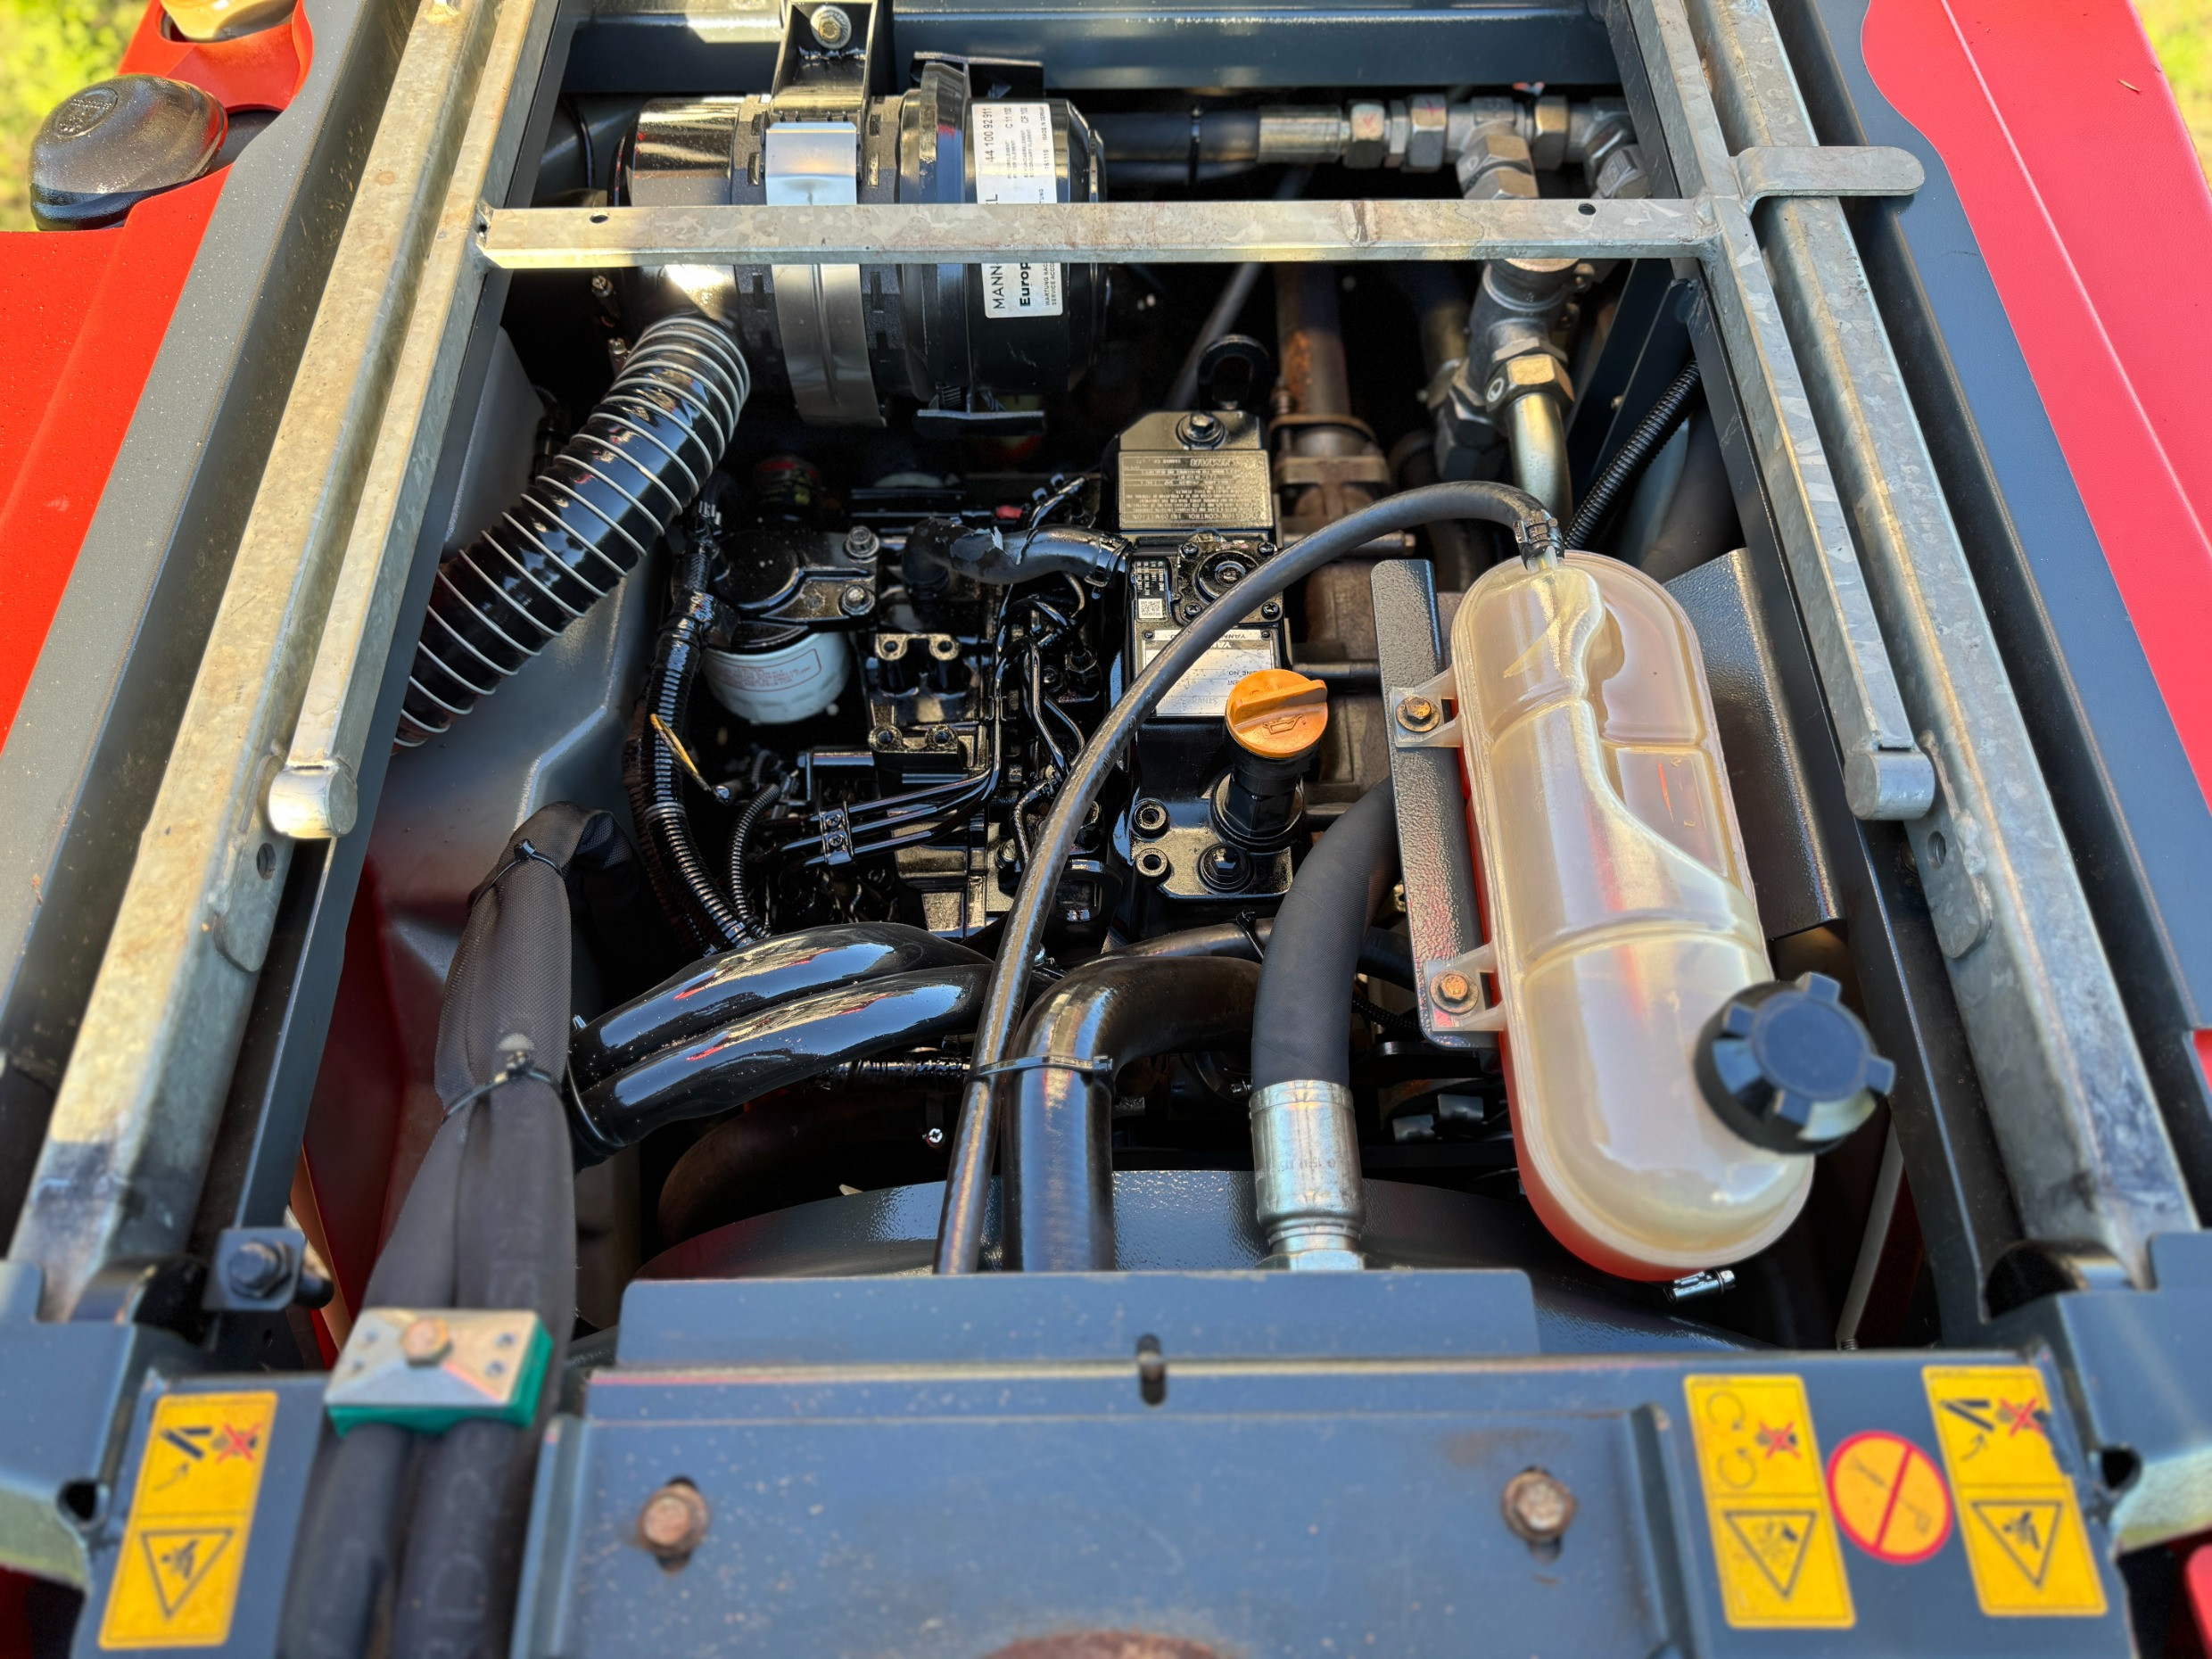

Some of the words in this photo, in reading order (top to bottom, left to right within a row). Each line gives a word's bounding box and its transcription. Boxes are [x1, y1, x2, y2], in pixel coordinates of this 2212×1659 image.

[982, 108, 992, 118] 911
[983, 120, 993, 128] 92
[984, 132, 994, 146] 100
[985, 150, 995, 161] 44
